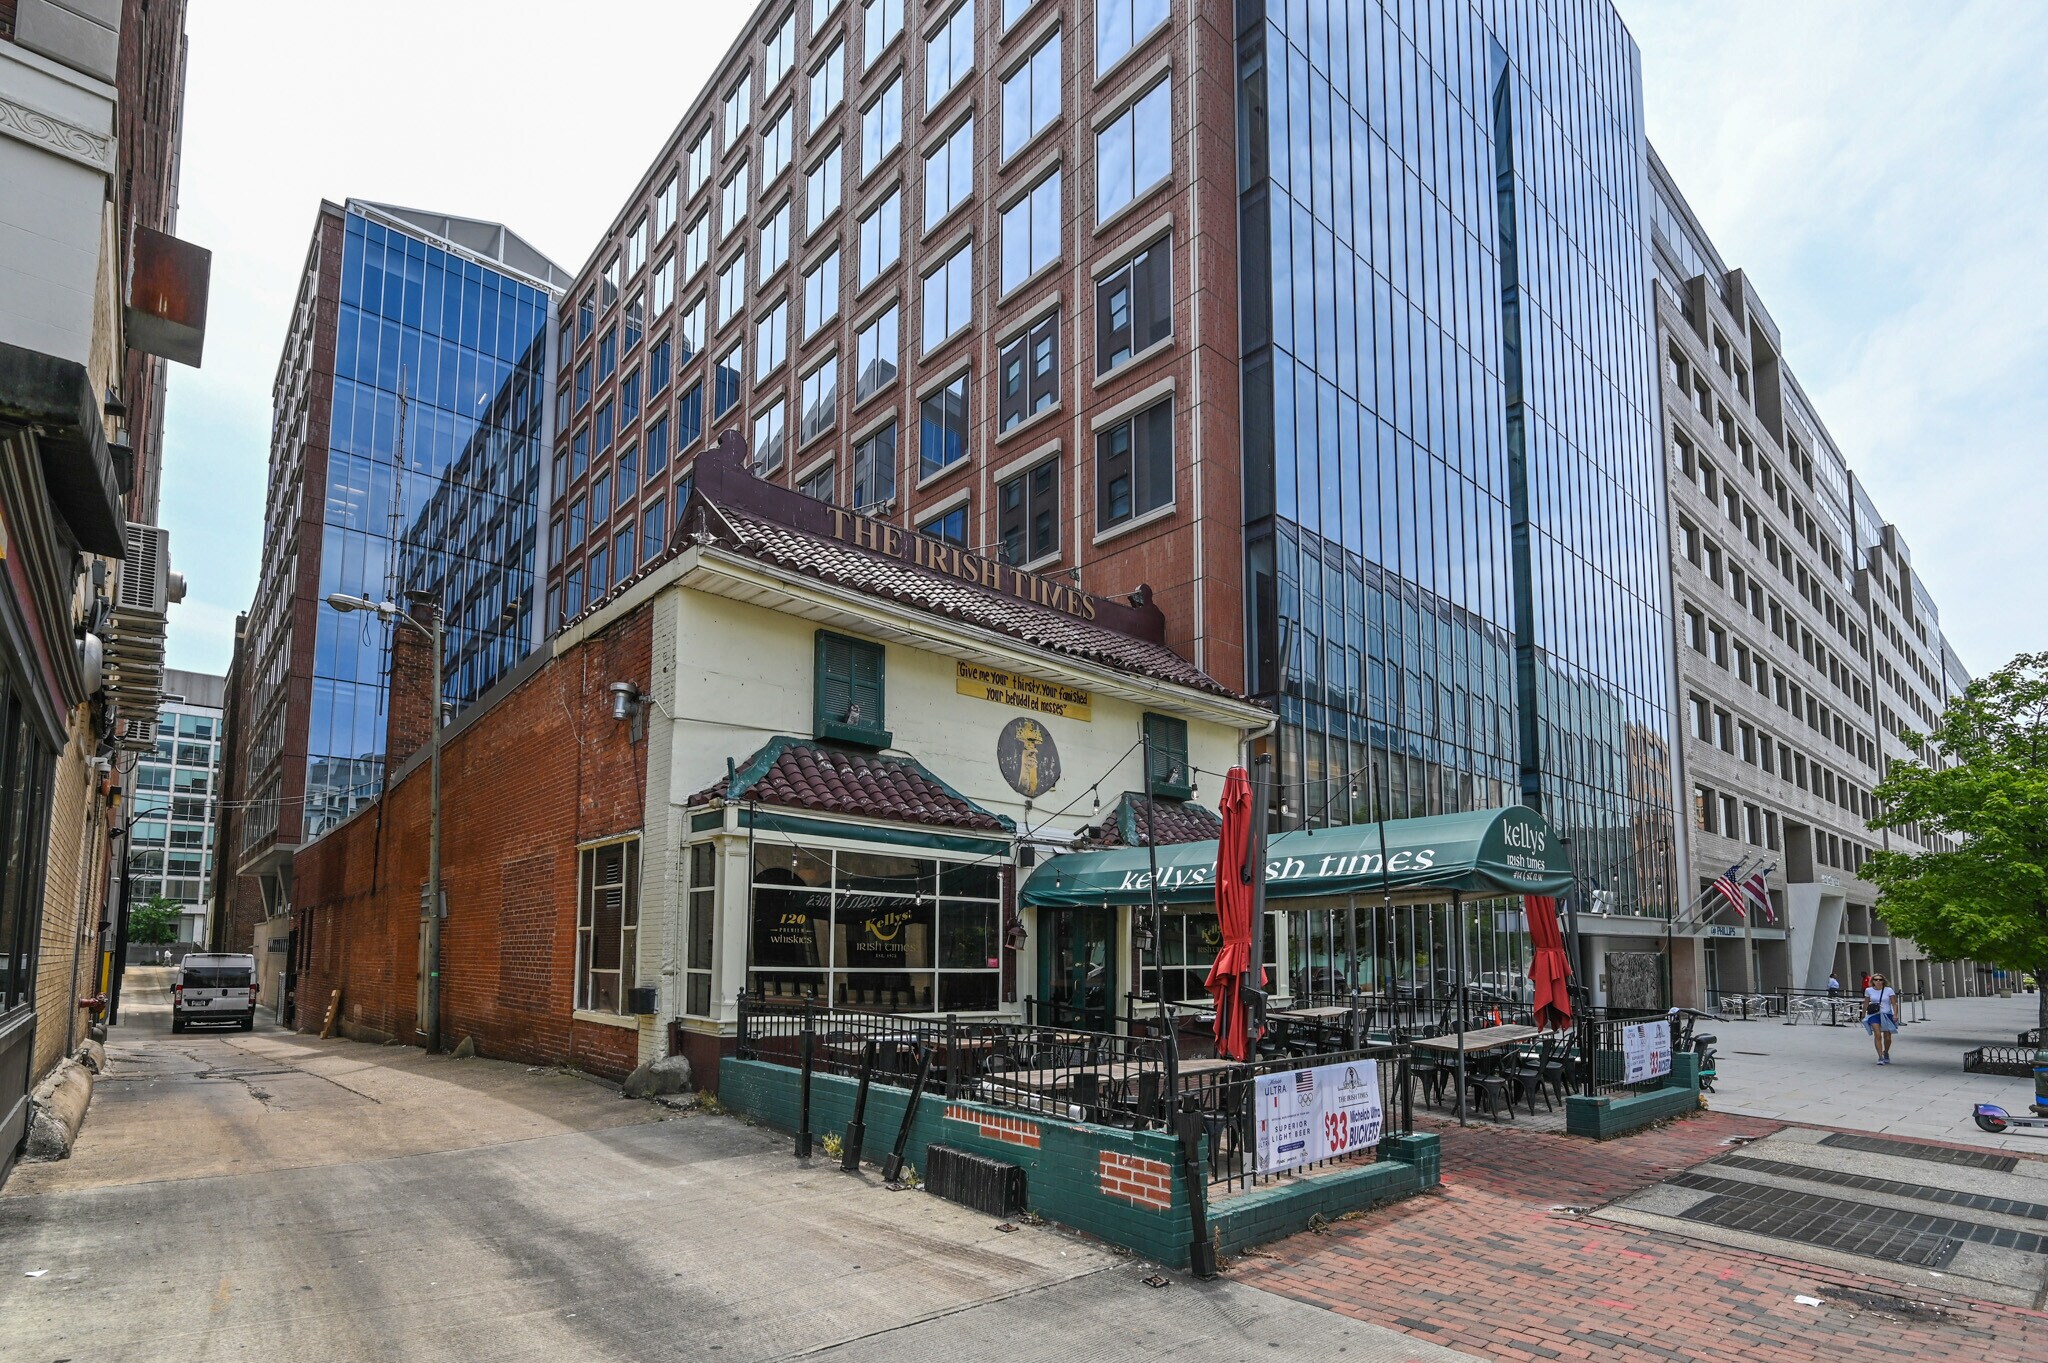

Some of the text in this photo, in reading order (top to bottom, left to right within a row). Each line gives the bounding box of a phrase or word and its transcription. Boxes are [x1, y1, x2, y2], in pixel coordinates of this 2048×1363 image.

[827, 507, 1096, 621] THE IRISH TIMES
[979, 671, 990, 682] me
[1319, 849, 1436, 877] times
[780, 914, 806, 925] 120
[1716, 926, 1736, 936] PHILLIPS
[770, 934, 813, 944] whiskies
[1265, 1084, 1287, 1096] ULTRA
[1338, 1091, 1369, 1103] THE IRISH TIMES
[1350, 1106, 1381, 1123] Michelob Ultra
[1274, 1119, 1308, 1133] SUPERIOR
[1324, 1111, 1348, 1152] $33
[1271, 1132, 1292, 1143] LIGHT
[1294, 1127, 1311, 1138] BEER
[1349, 1121, 1380, 1147] BUCKETS
